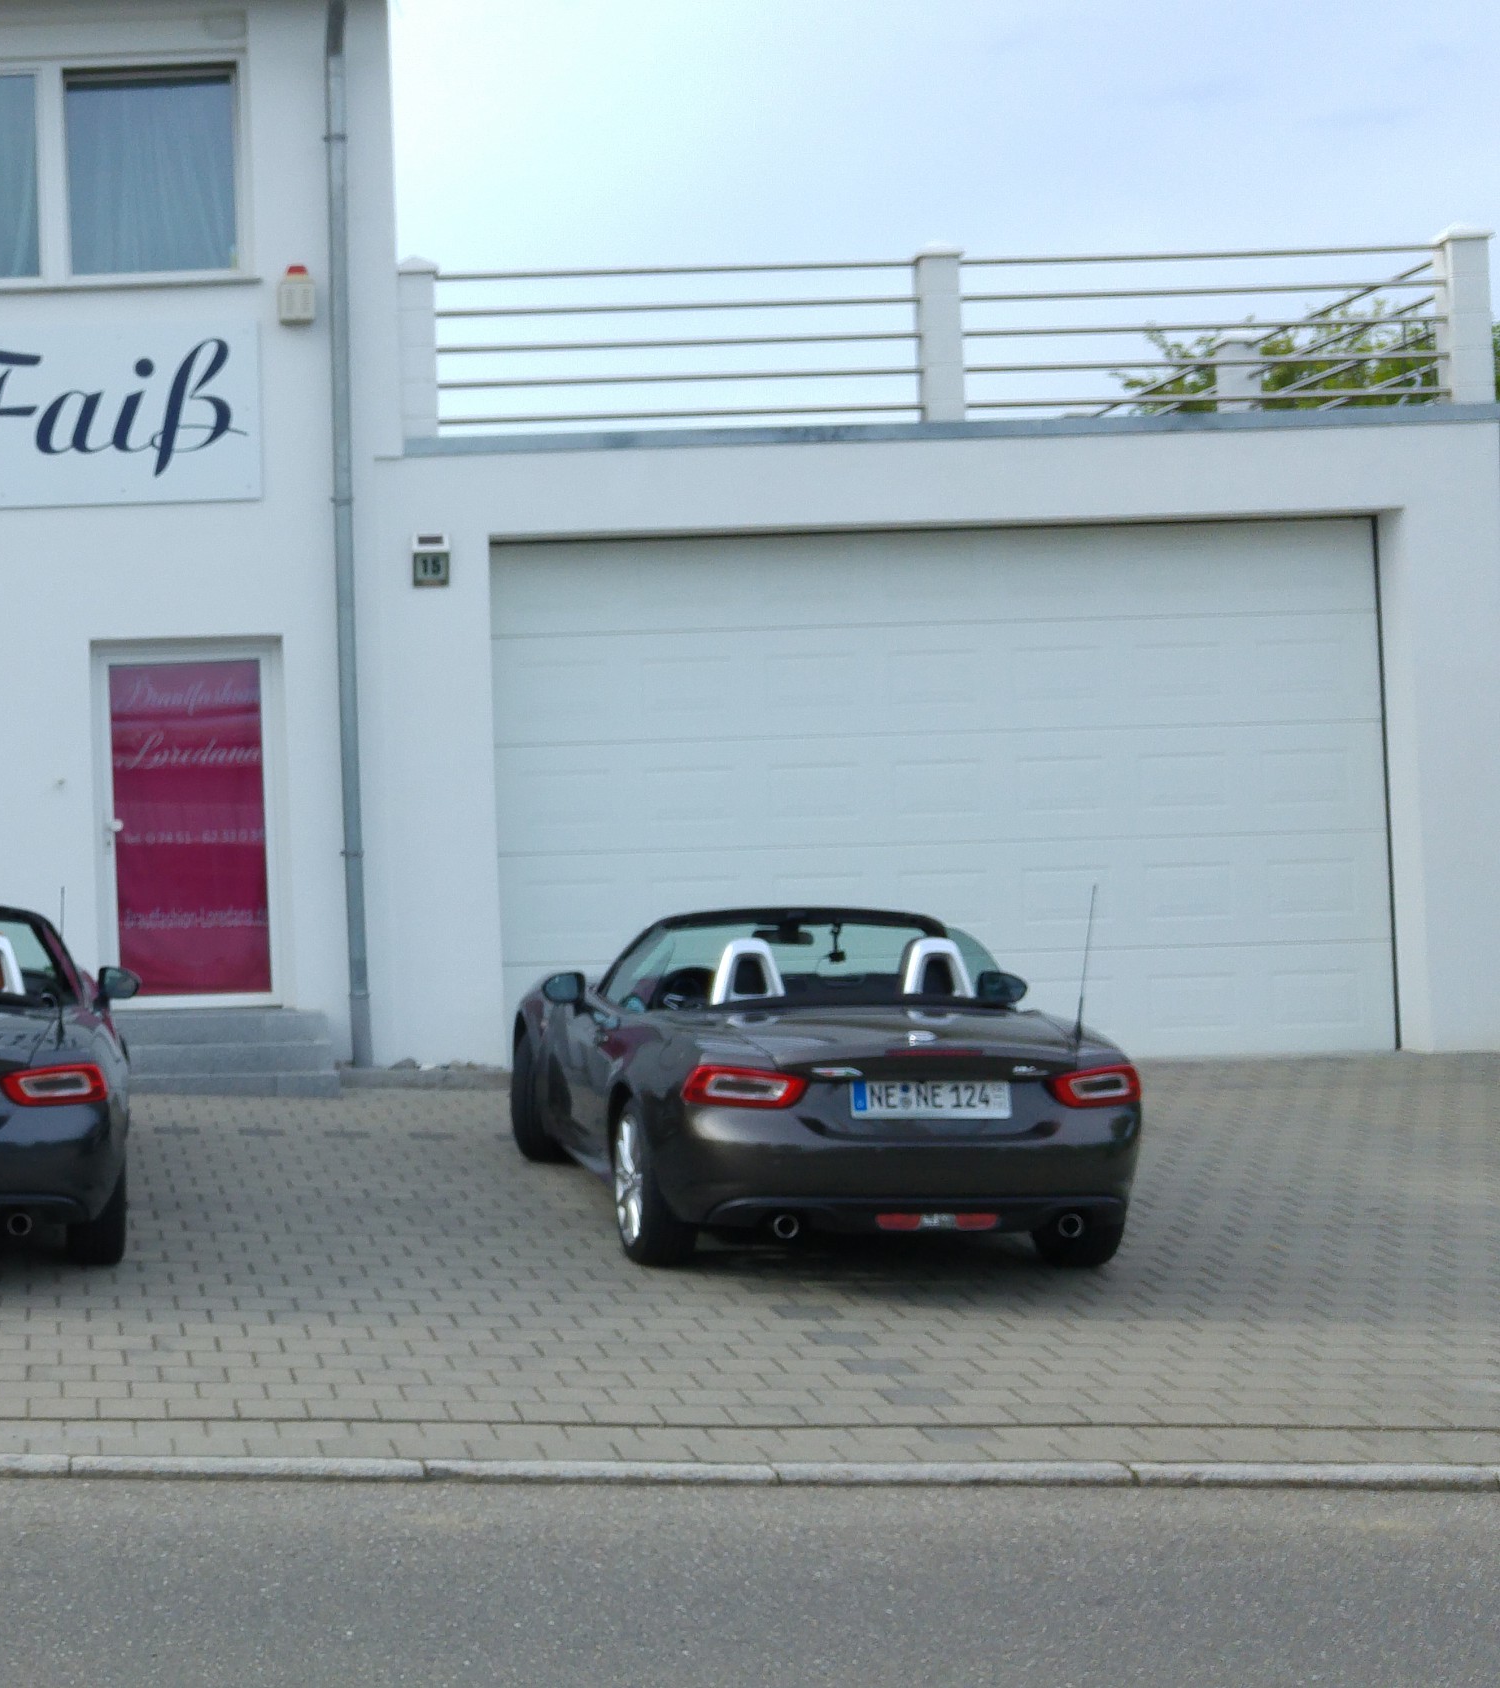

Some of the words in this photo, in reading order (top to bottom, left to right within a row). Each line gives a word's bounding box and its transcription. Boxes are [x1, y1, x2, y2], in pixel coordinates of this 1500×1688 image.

[421, 556, 442, 576] 15
[870, 1084, 898, 1109] NE
[915, 1084, 943, 1109] NE
[950, 1085, 990, 1108] 124
